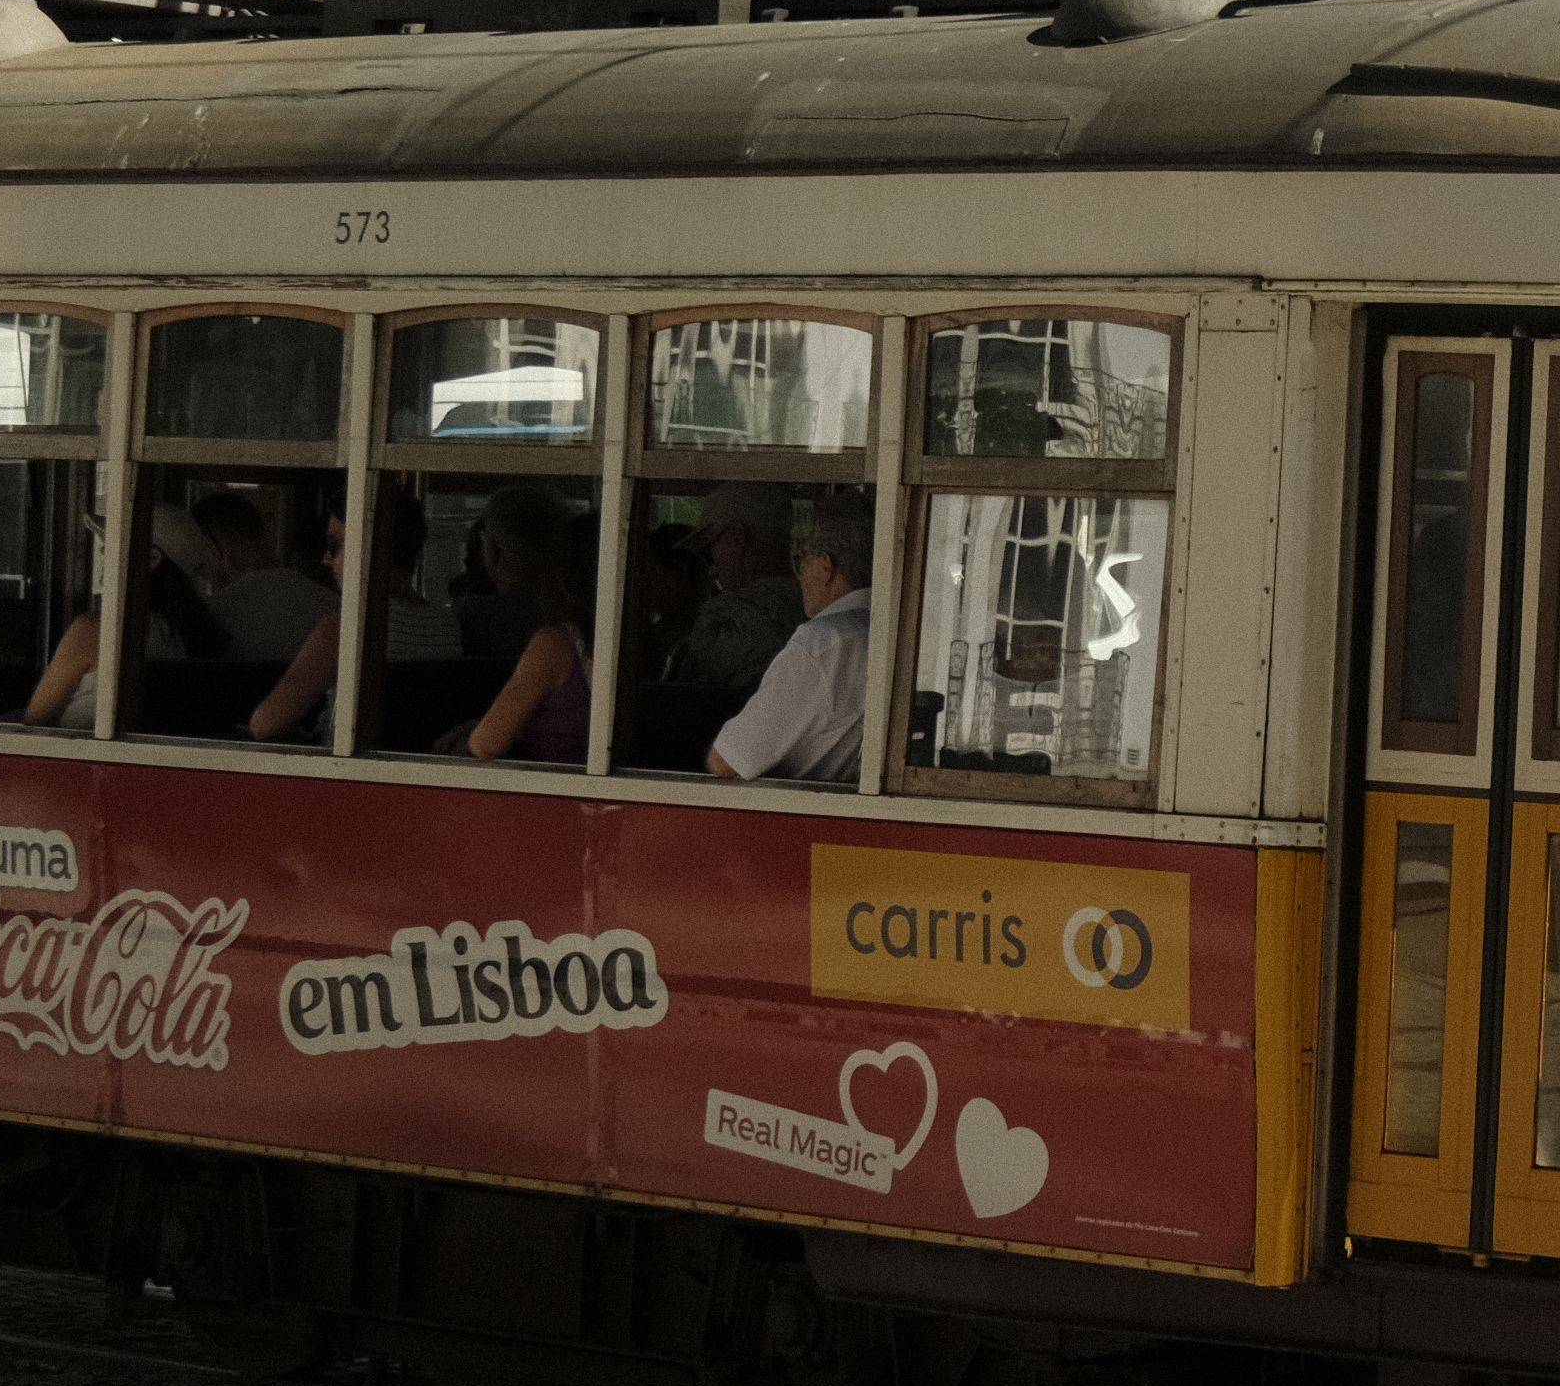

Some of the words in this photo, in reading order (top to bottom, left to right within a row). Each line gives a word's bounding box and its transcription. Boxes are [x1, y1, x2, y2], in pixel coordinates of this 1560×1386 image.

[335, 210, 391, 245] 573
[846, 889, 1028, 968] carris
[288, 964, 402, 1038] em
[405, 933, 658, 1030] Lisboa
[717, 1104, 782, 1150] Real
